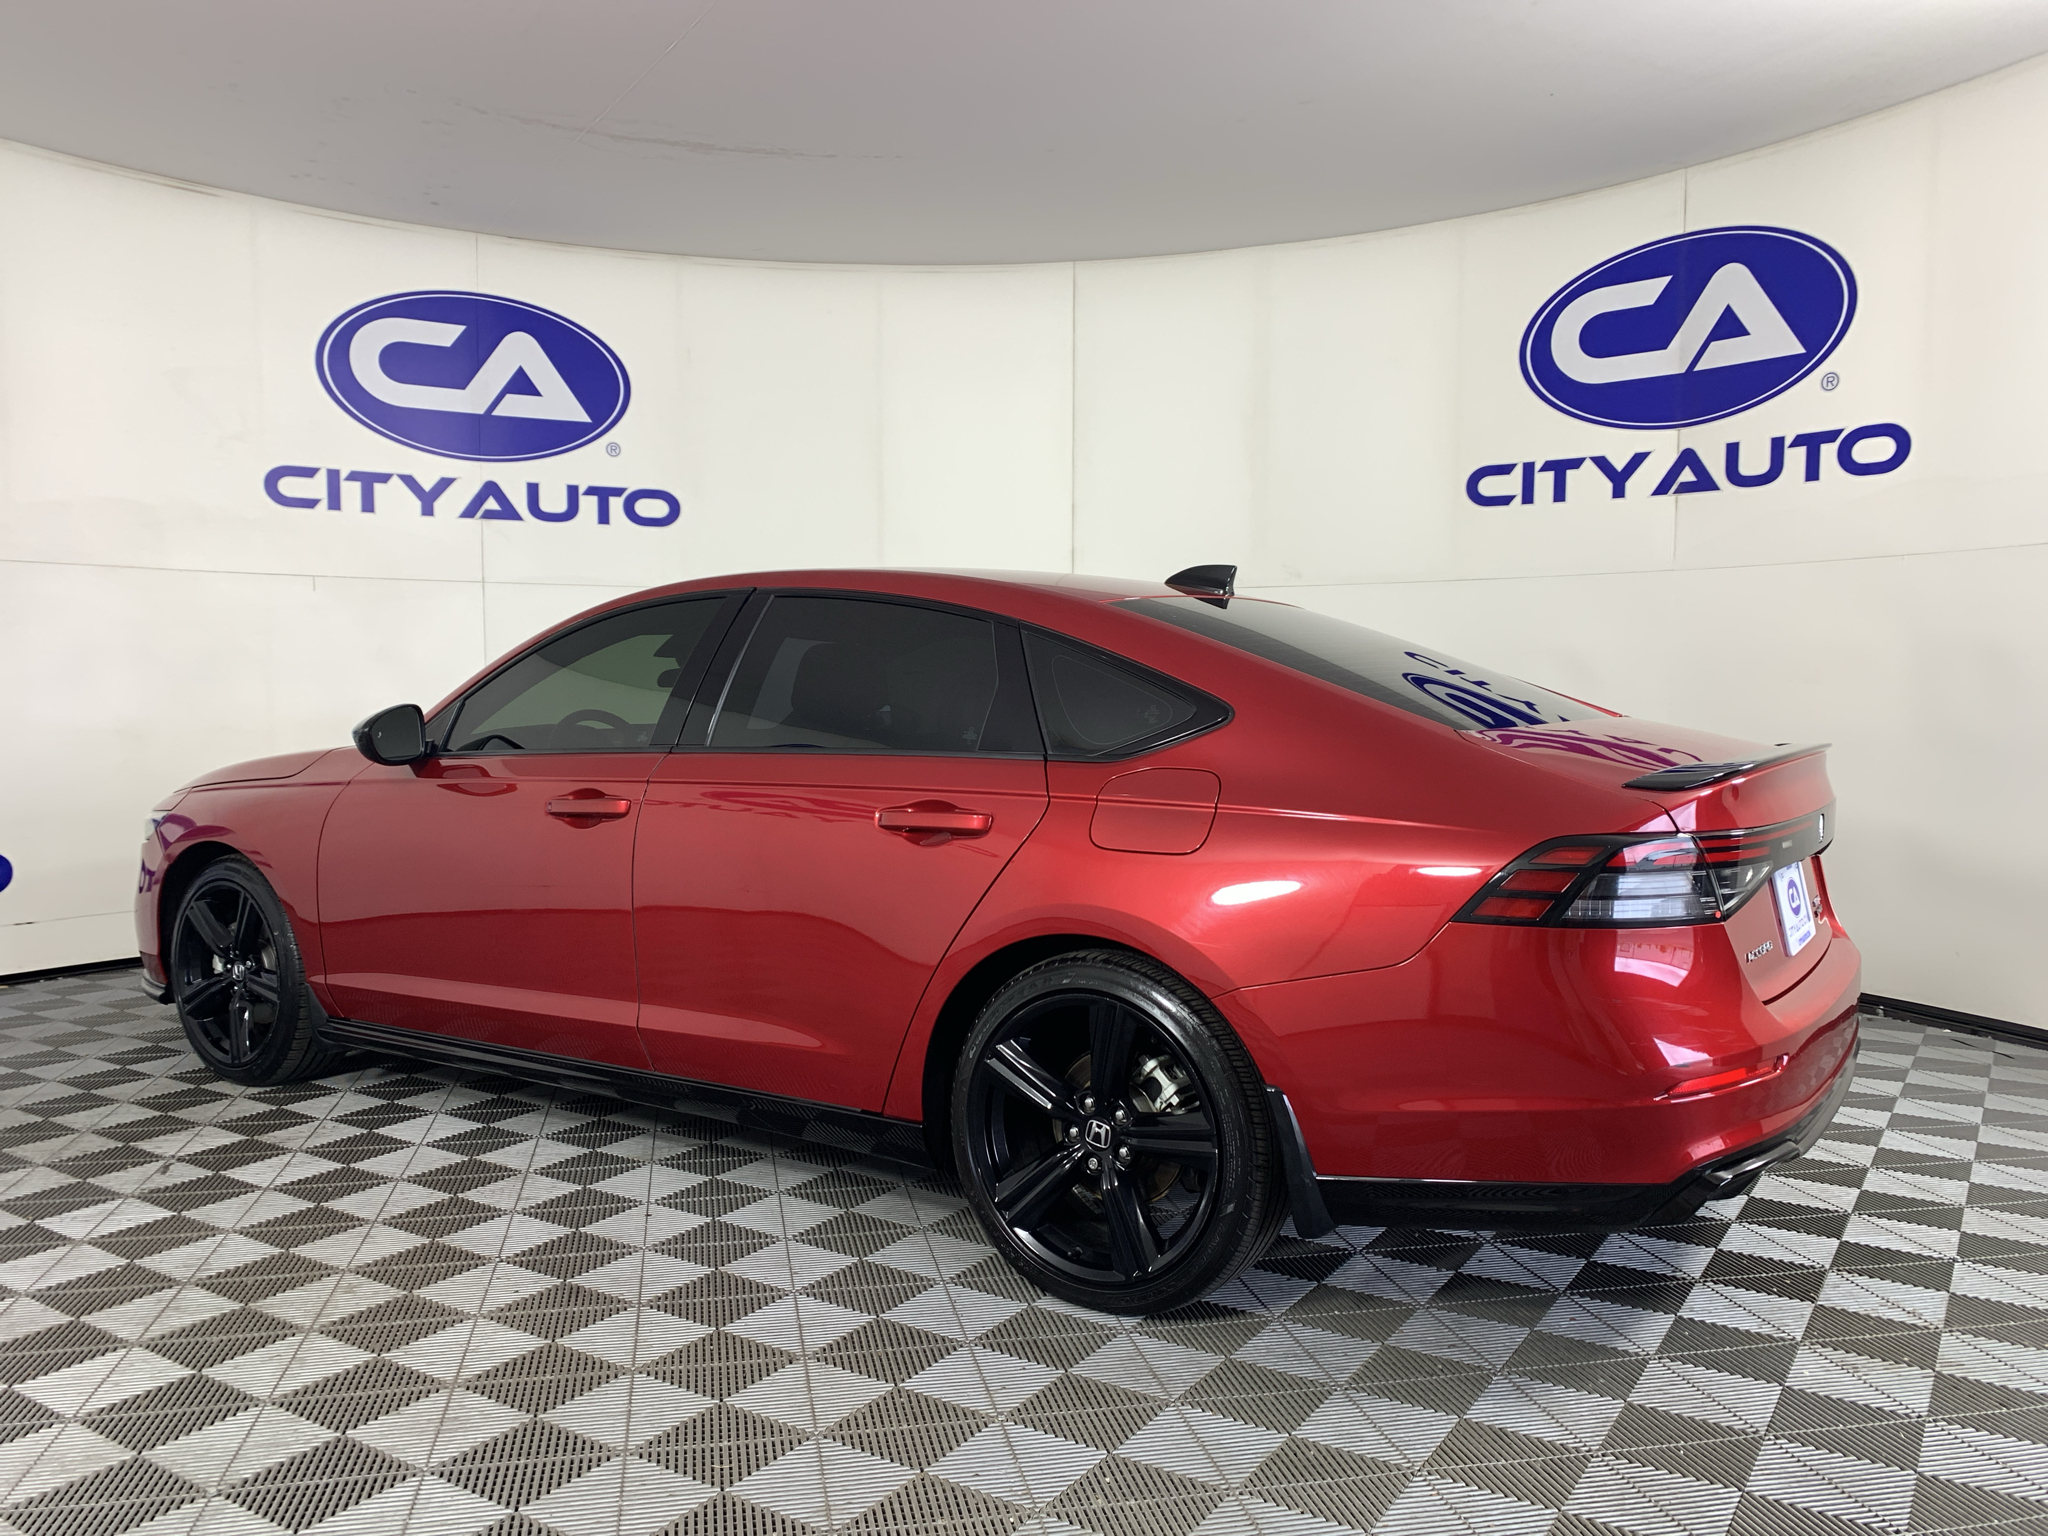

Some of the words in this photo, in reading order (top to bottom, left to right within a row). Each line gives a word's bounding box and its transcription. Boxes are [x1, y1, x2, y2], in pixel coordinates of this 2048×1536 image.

[349, 317, 593, 423] CA
[1550, 262, 1807, 384] CA
[263, 465, 459, 518] CITY
[458, 480, 681, 527] AUTO
[1465, 450, 1653, 507] CITY
[1650, 423, 1912, 497] AUTO
